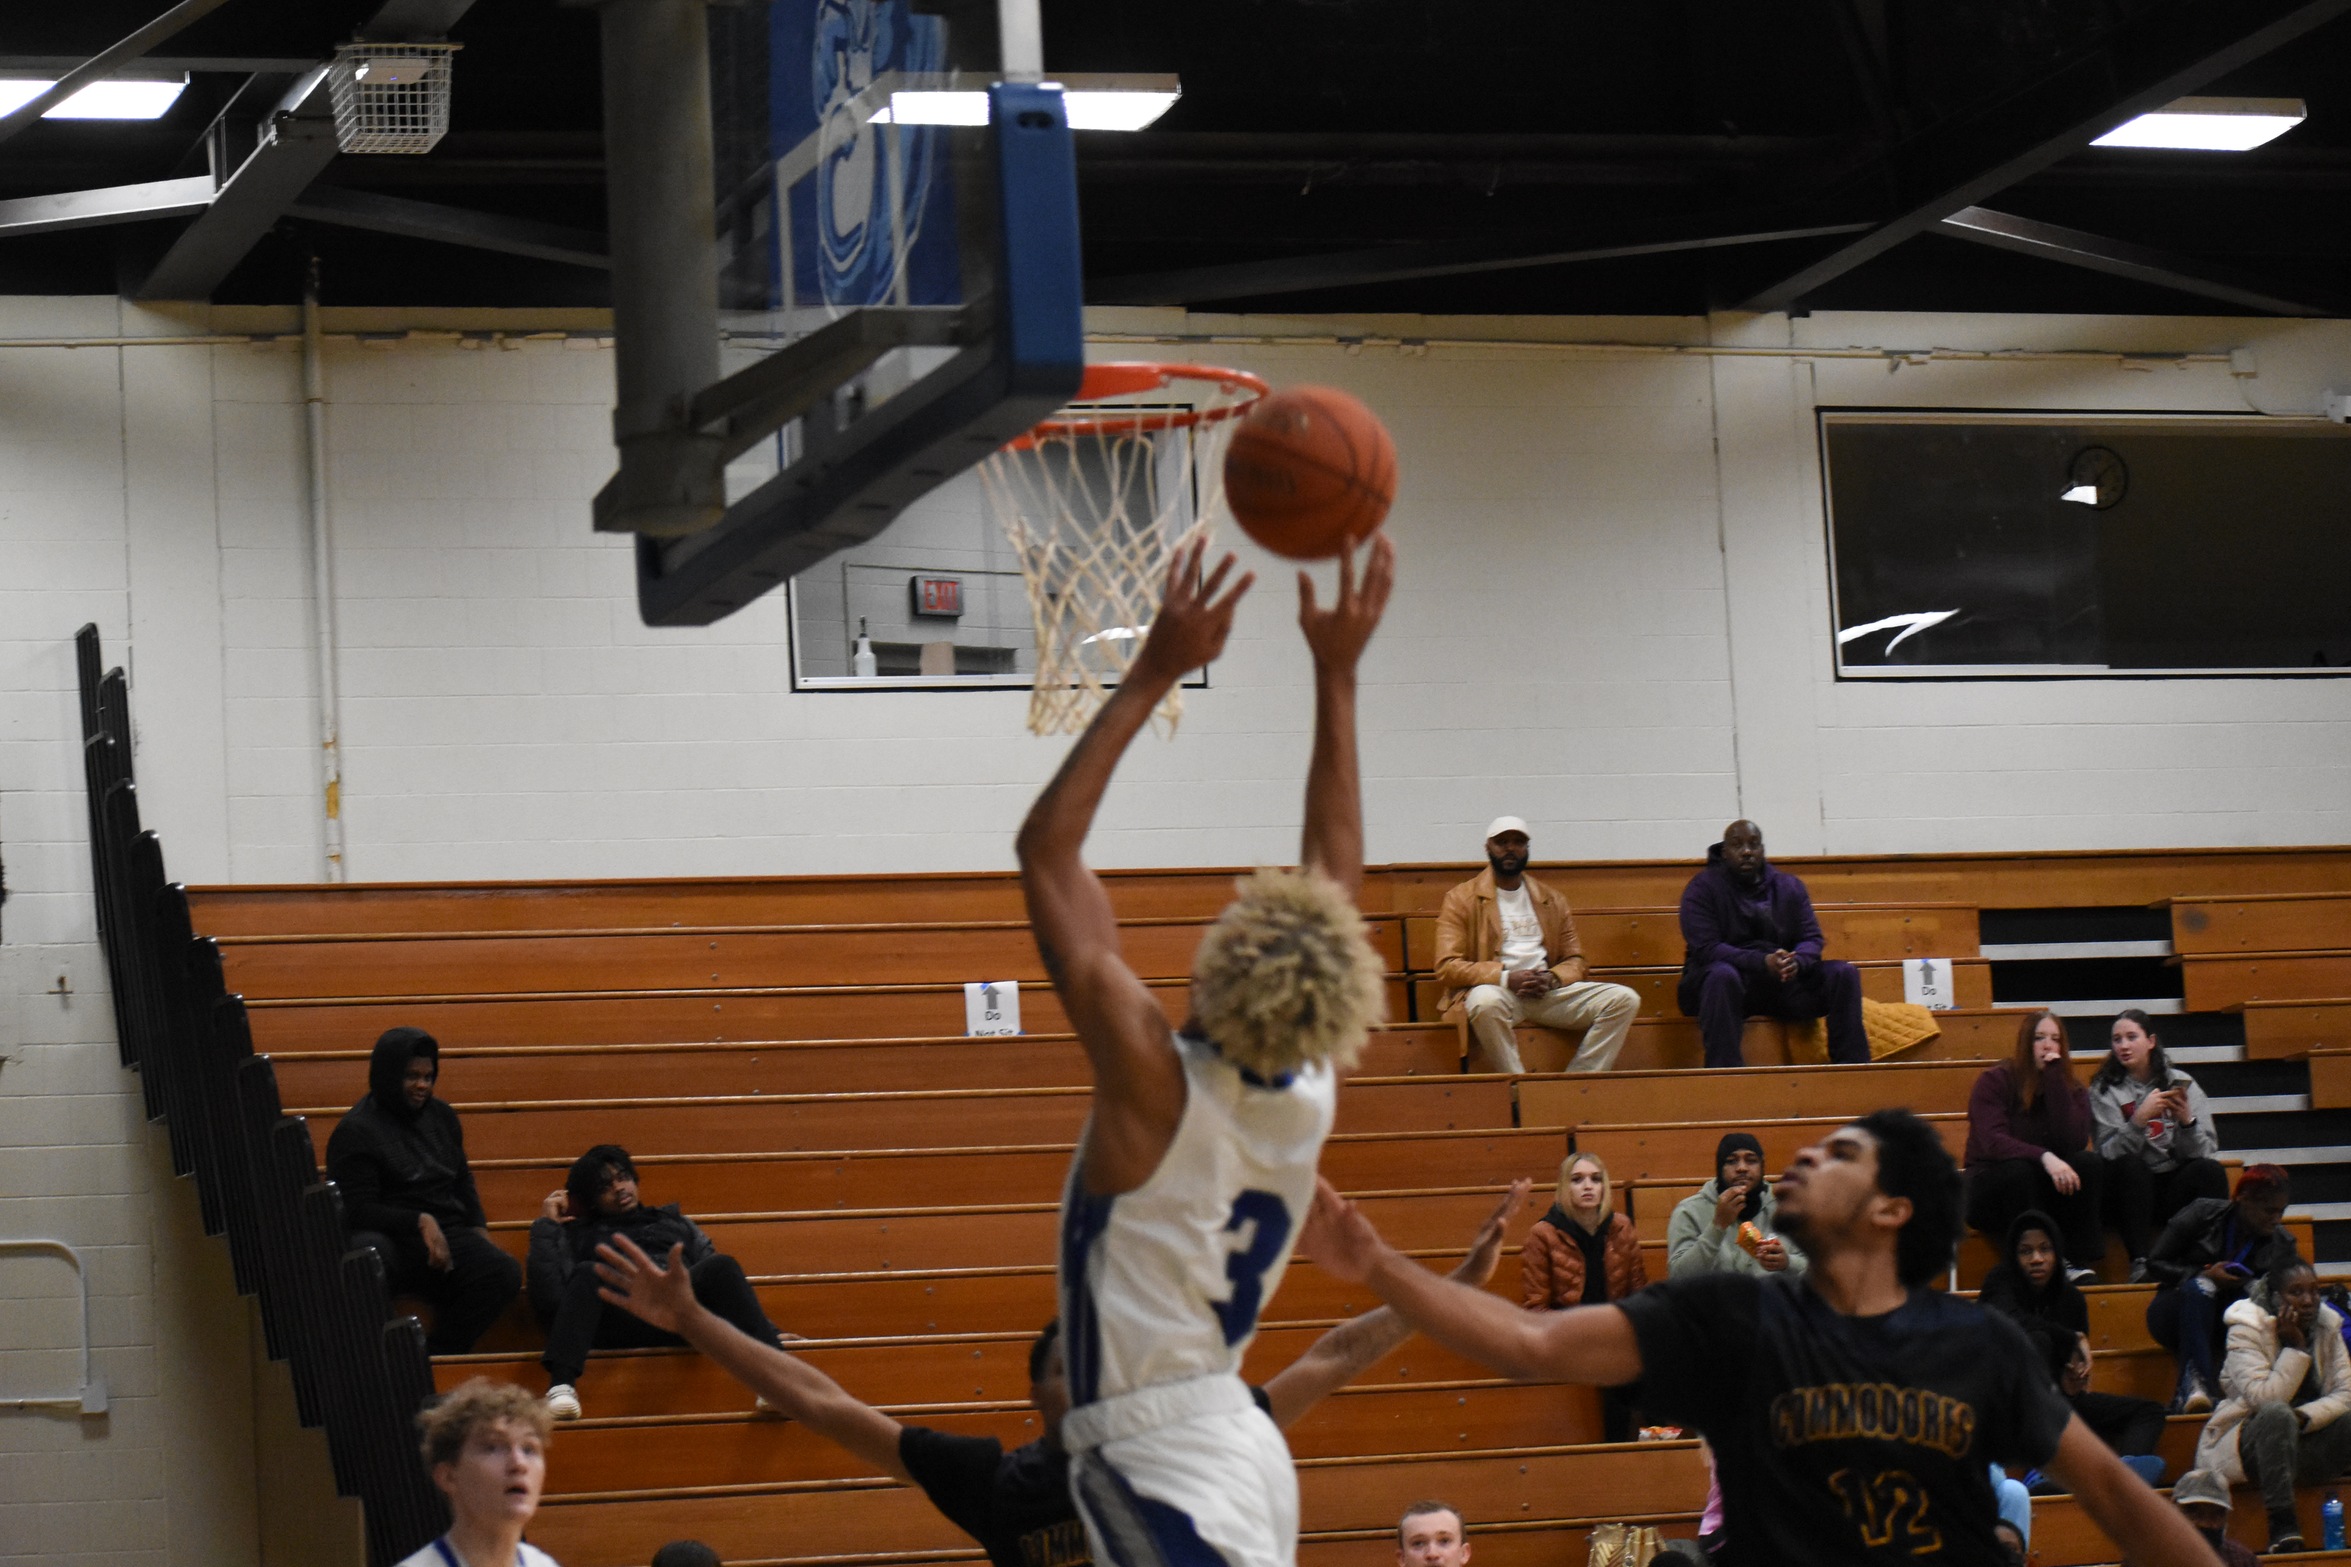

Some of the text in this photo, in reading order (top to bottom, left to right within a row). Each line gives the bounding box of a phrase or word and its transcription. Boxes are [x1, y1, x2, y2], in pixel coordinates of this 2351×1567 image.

[1921, 986, 1937, 995] Do
[985, 1011, 1001, 1020] Do
[1206, 1188, 1292, 1348] 3
[1826, 1467, 1944, 1557] 12
